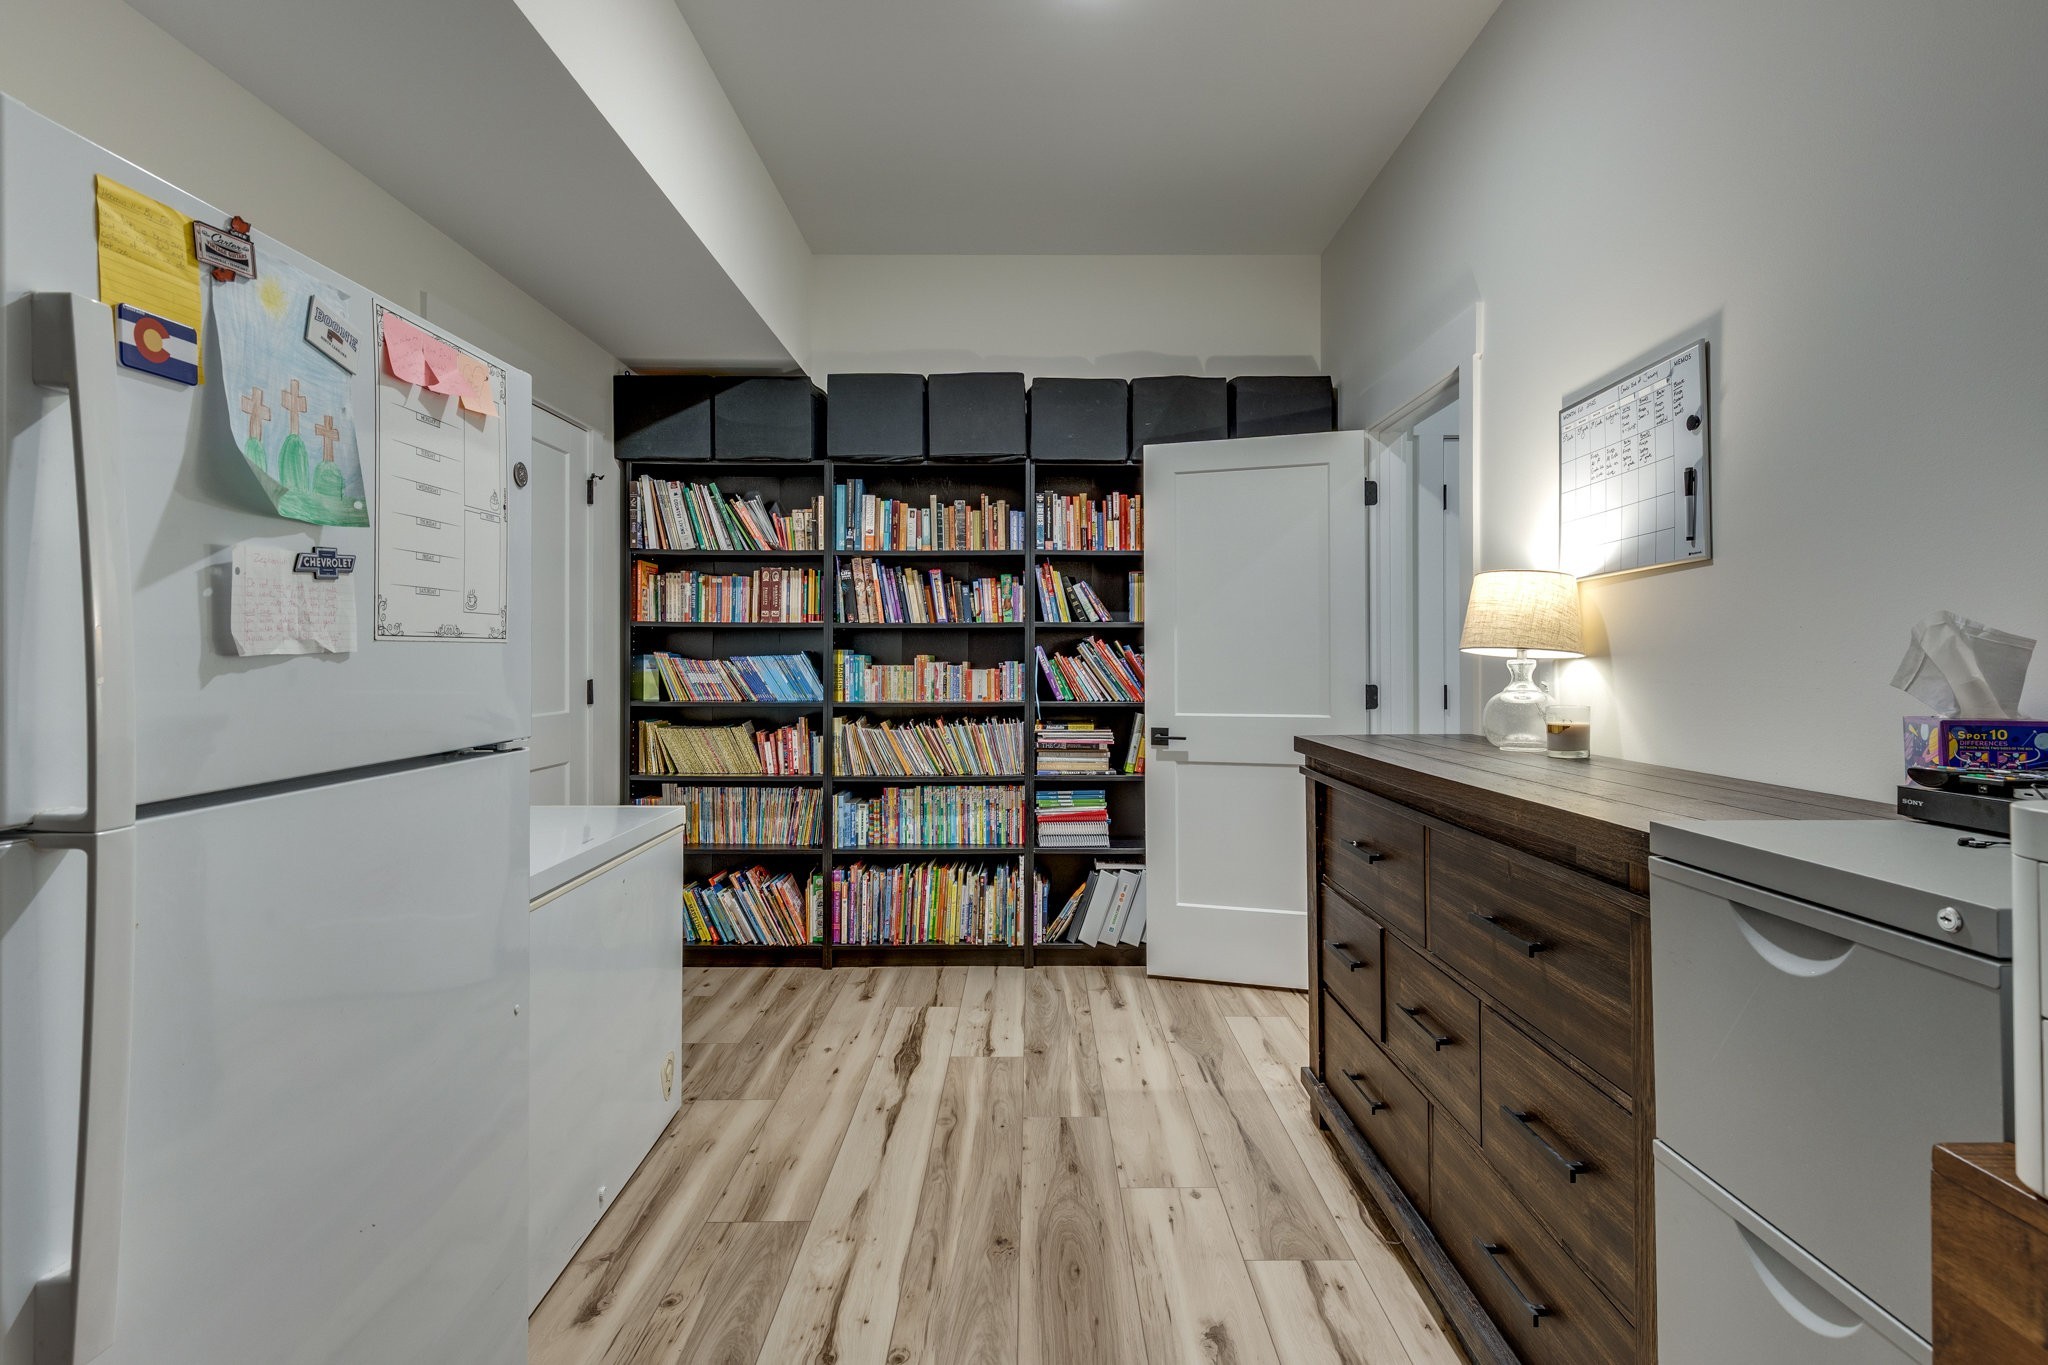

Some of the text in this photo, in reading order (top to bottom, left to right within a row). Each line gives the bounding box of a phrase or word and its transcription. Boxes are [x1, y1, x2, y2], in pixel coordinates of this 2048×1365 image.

[211, 233, 242, 252] Carter
[314, 306, 359, 353] BOONE
[1673, 353, 1693, 367] MEMOS
[673, 499, 687, 535] COUNTRY LIVING
[303, 556, 353, 568] CHEVROLET
[1957, 729, 2008, 740] SPOT 10
[1901, 798, 1924, 807] SONY
